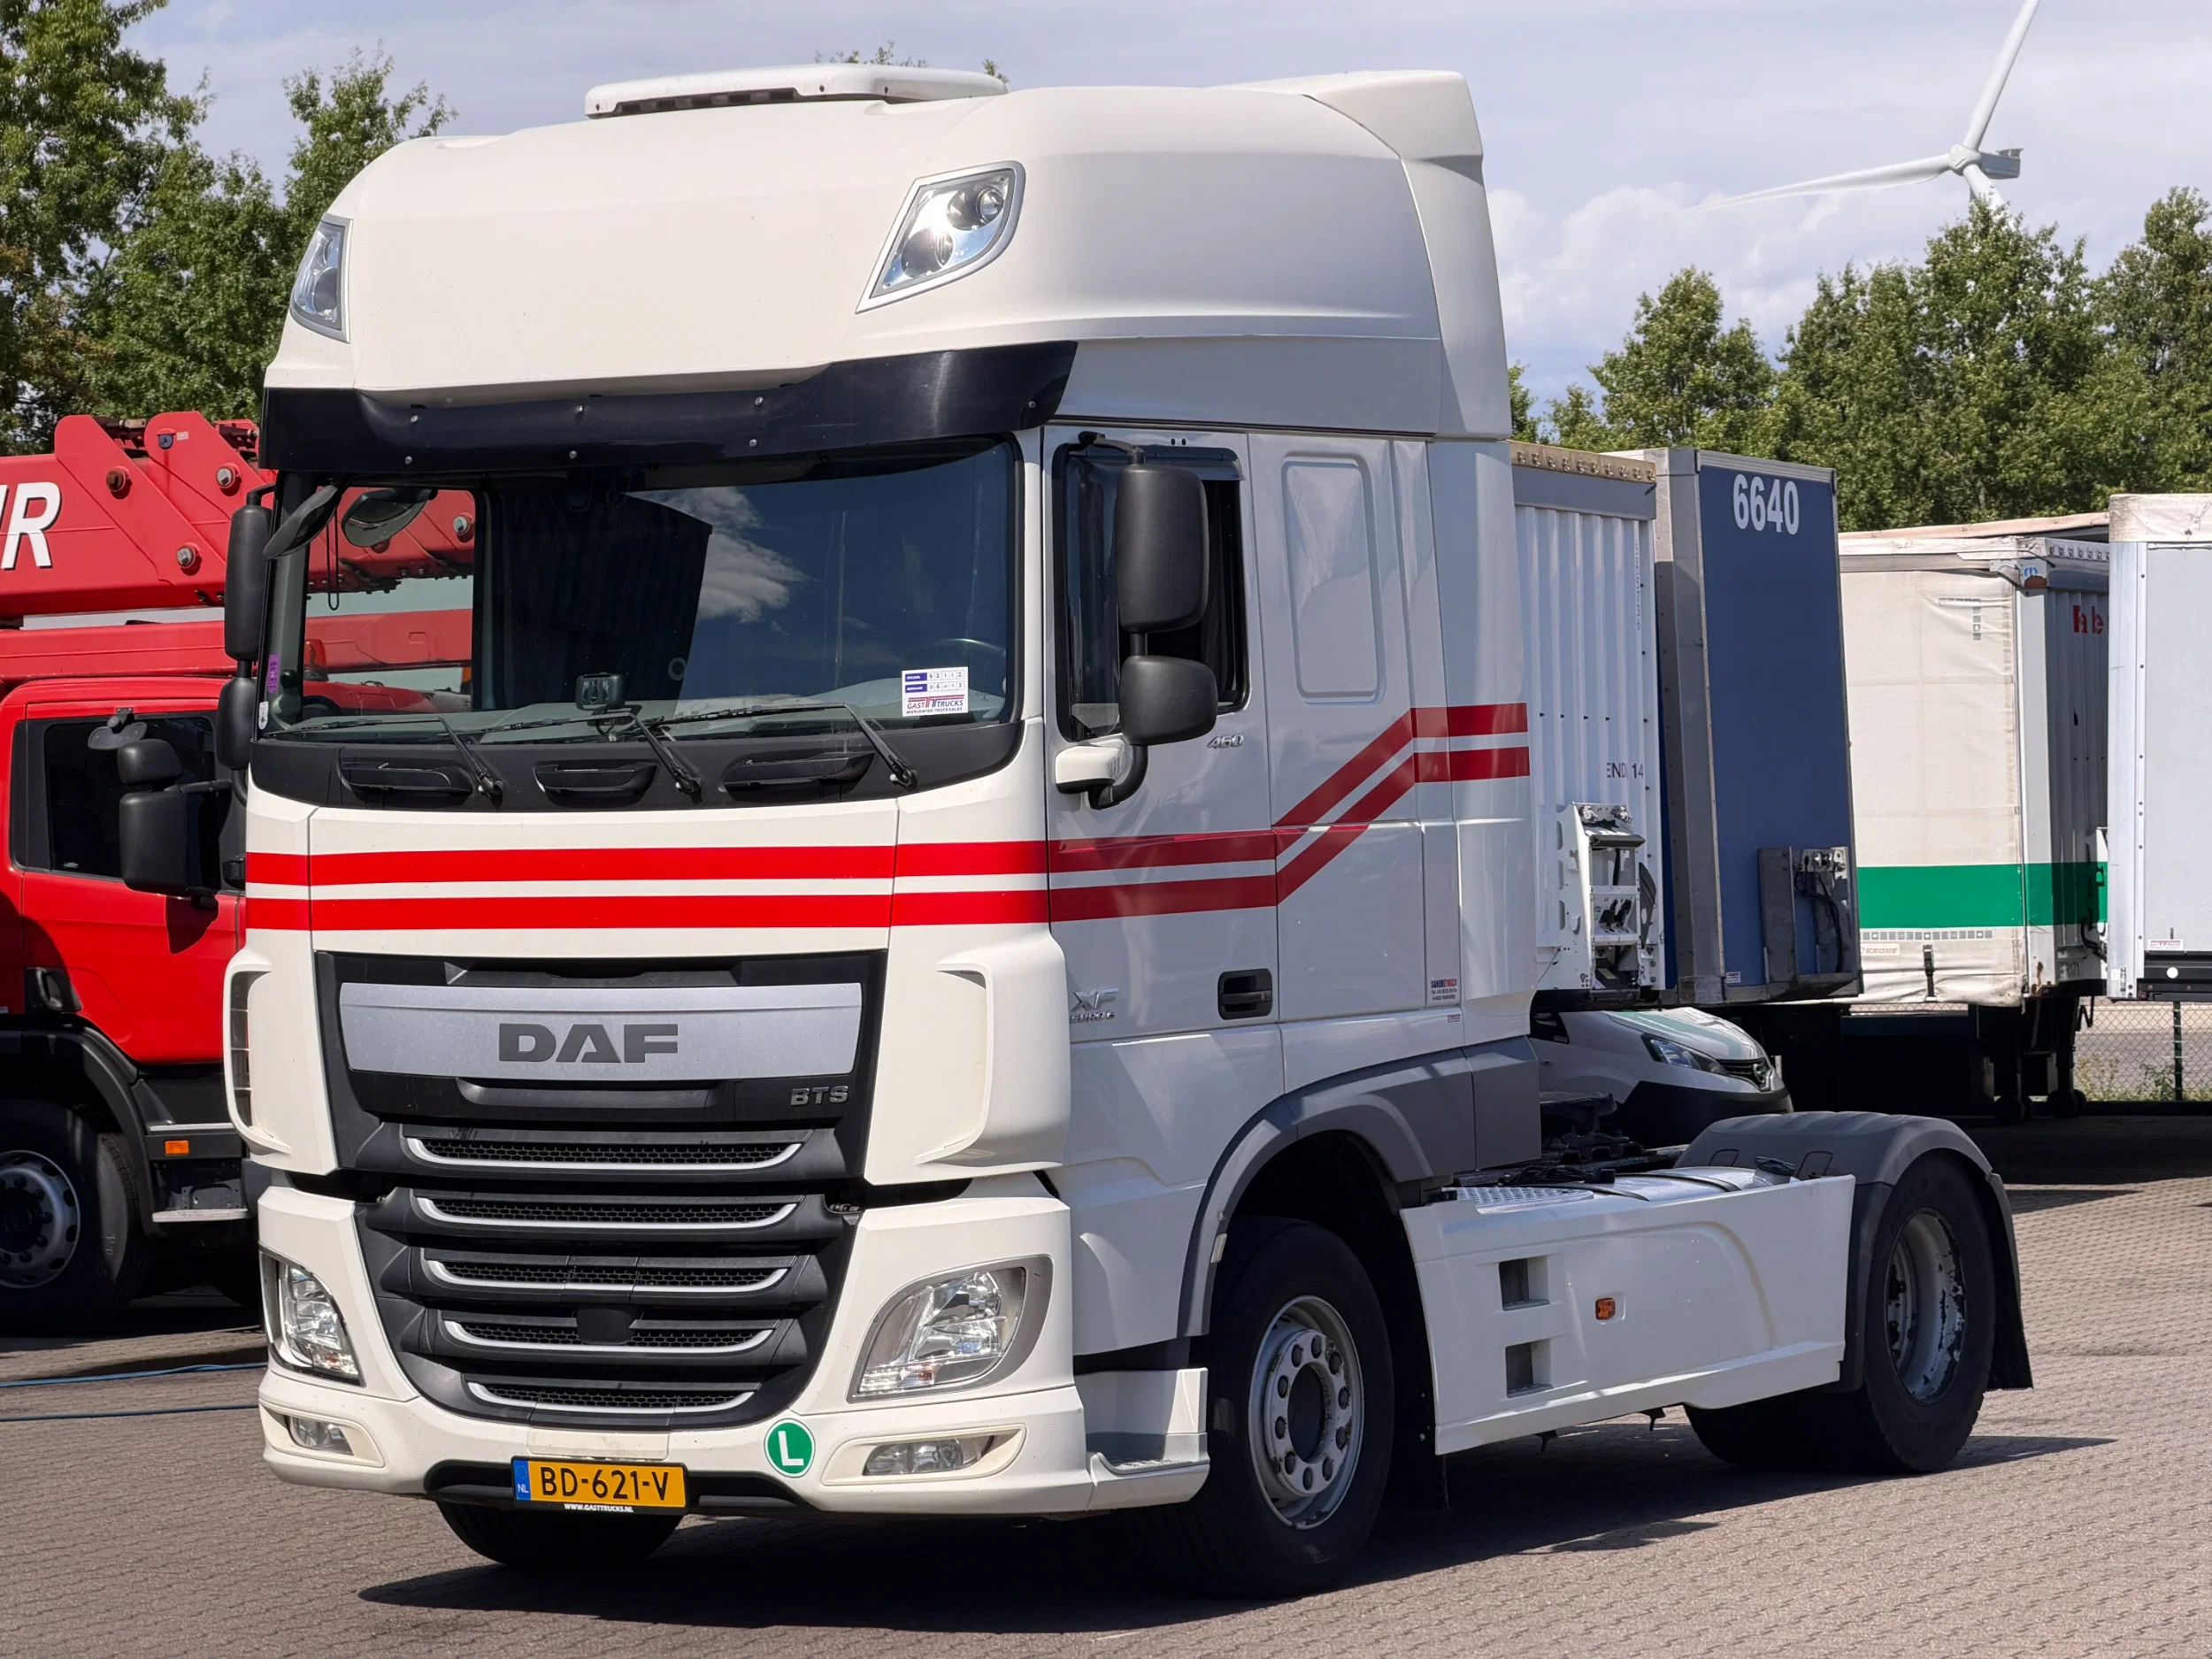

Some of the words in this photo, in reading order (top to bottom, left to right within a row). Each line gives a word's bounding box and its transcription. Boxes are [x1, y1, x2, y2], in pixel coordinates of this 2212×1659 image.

[1732, 473, 1800, 535] 6640
[0, 481, 63, 571] R
[1206, 734, 1244, 749] 460
[1071, 987, 1119, 1012] XF
[499, 1023, 679, 1064] DAF
[790, 1085, 849, 1106] BTS
[778, 1430, 804, 1466] L
[517, 1483, 530, 1494] NL
[540, 1466, 669, 1501] BD-621-V
[564, 1502, 634, 1513] WWW.GASTTRUCKS.NL
